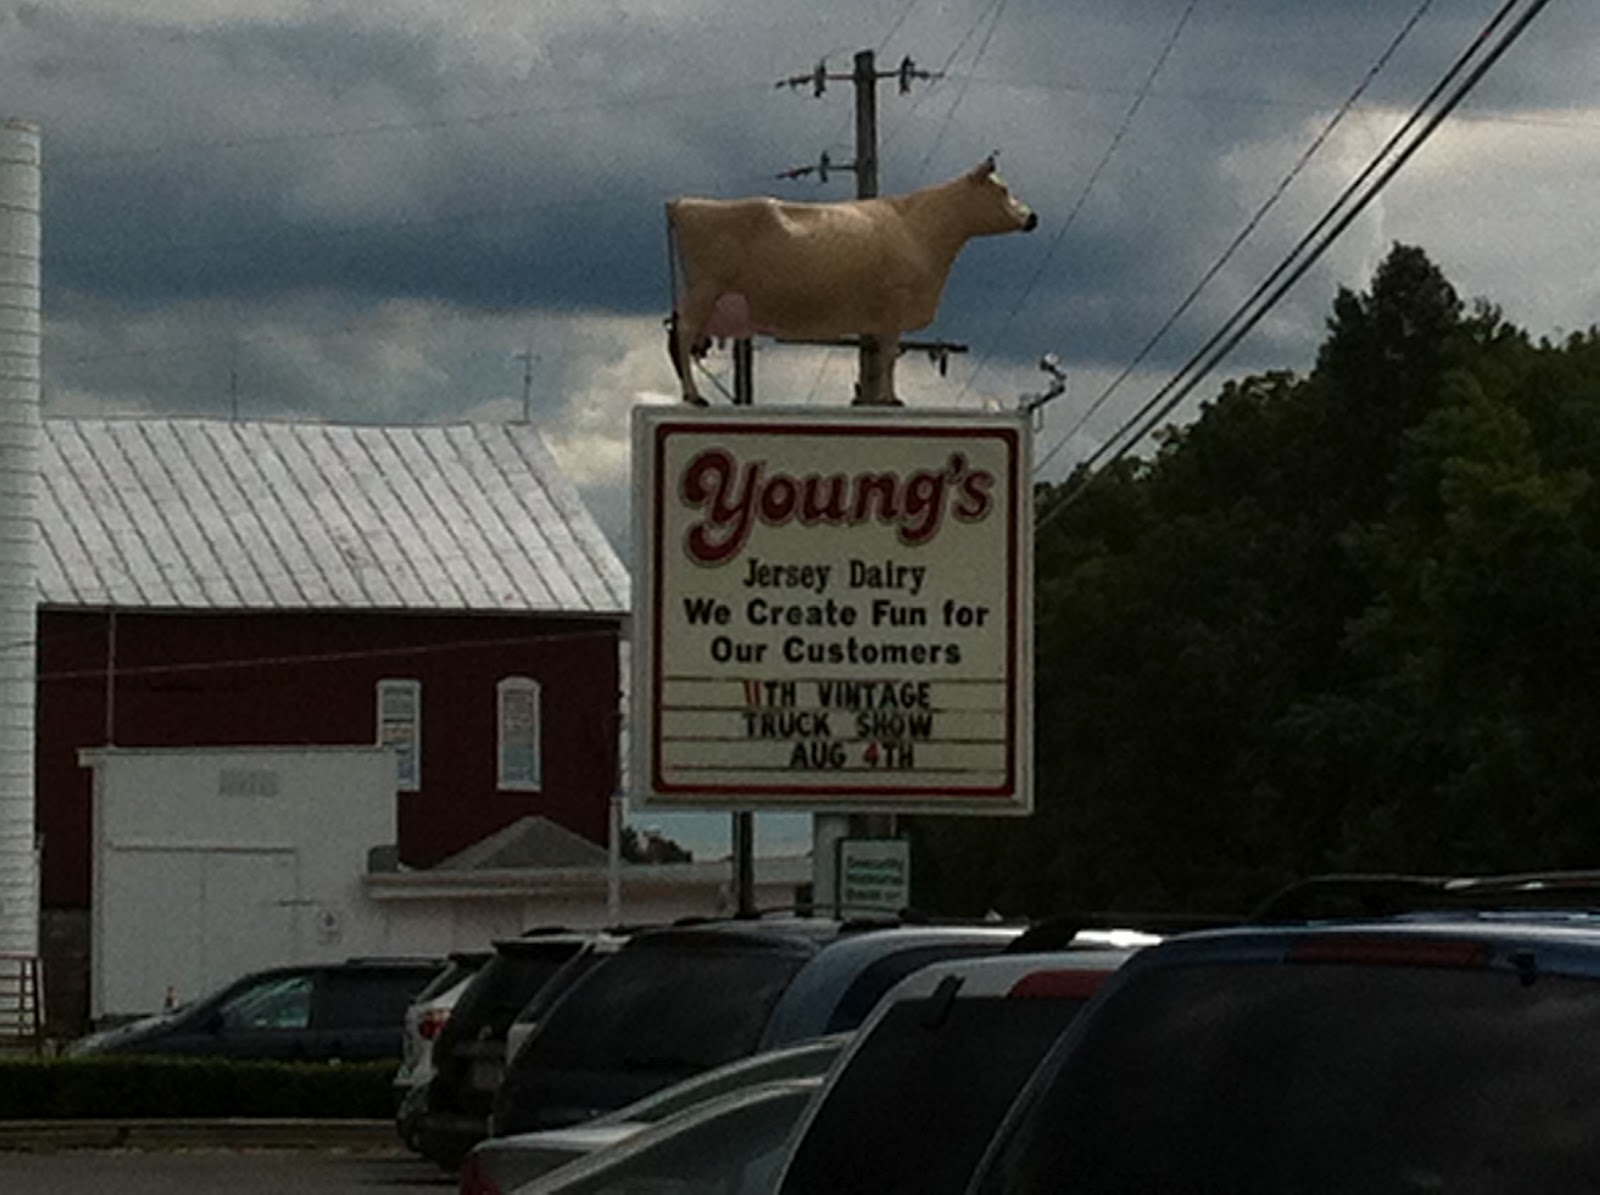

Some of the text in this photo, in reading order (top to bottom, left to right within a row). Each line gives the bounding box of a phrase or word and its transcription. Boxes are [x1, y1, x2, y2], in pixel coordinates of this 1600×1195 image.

[678, 447, 996, 568] Young's
[742, 558, 927, 596] Jersey Dairy
[684, 598, 990, 627] We Create Fun for
[710, 634, 962, 665] Our Customers
[744, 680, 932, 709] 11TH VINTAGE
[743, 711, 934, 738] TRUCK SHOW
[790, 741, 914, 769] AUG 4TH
